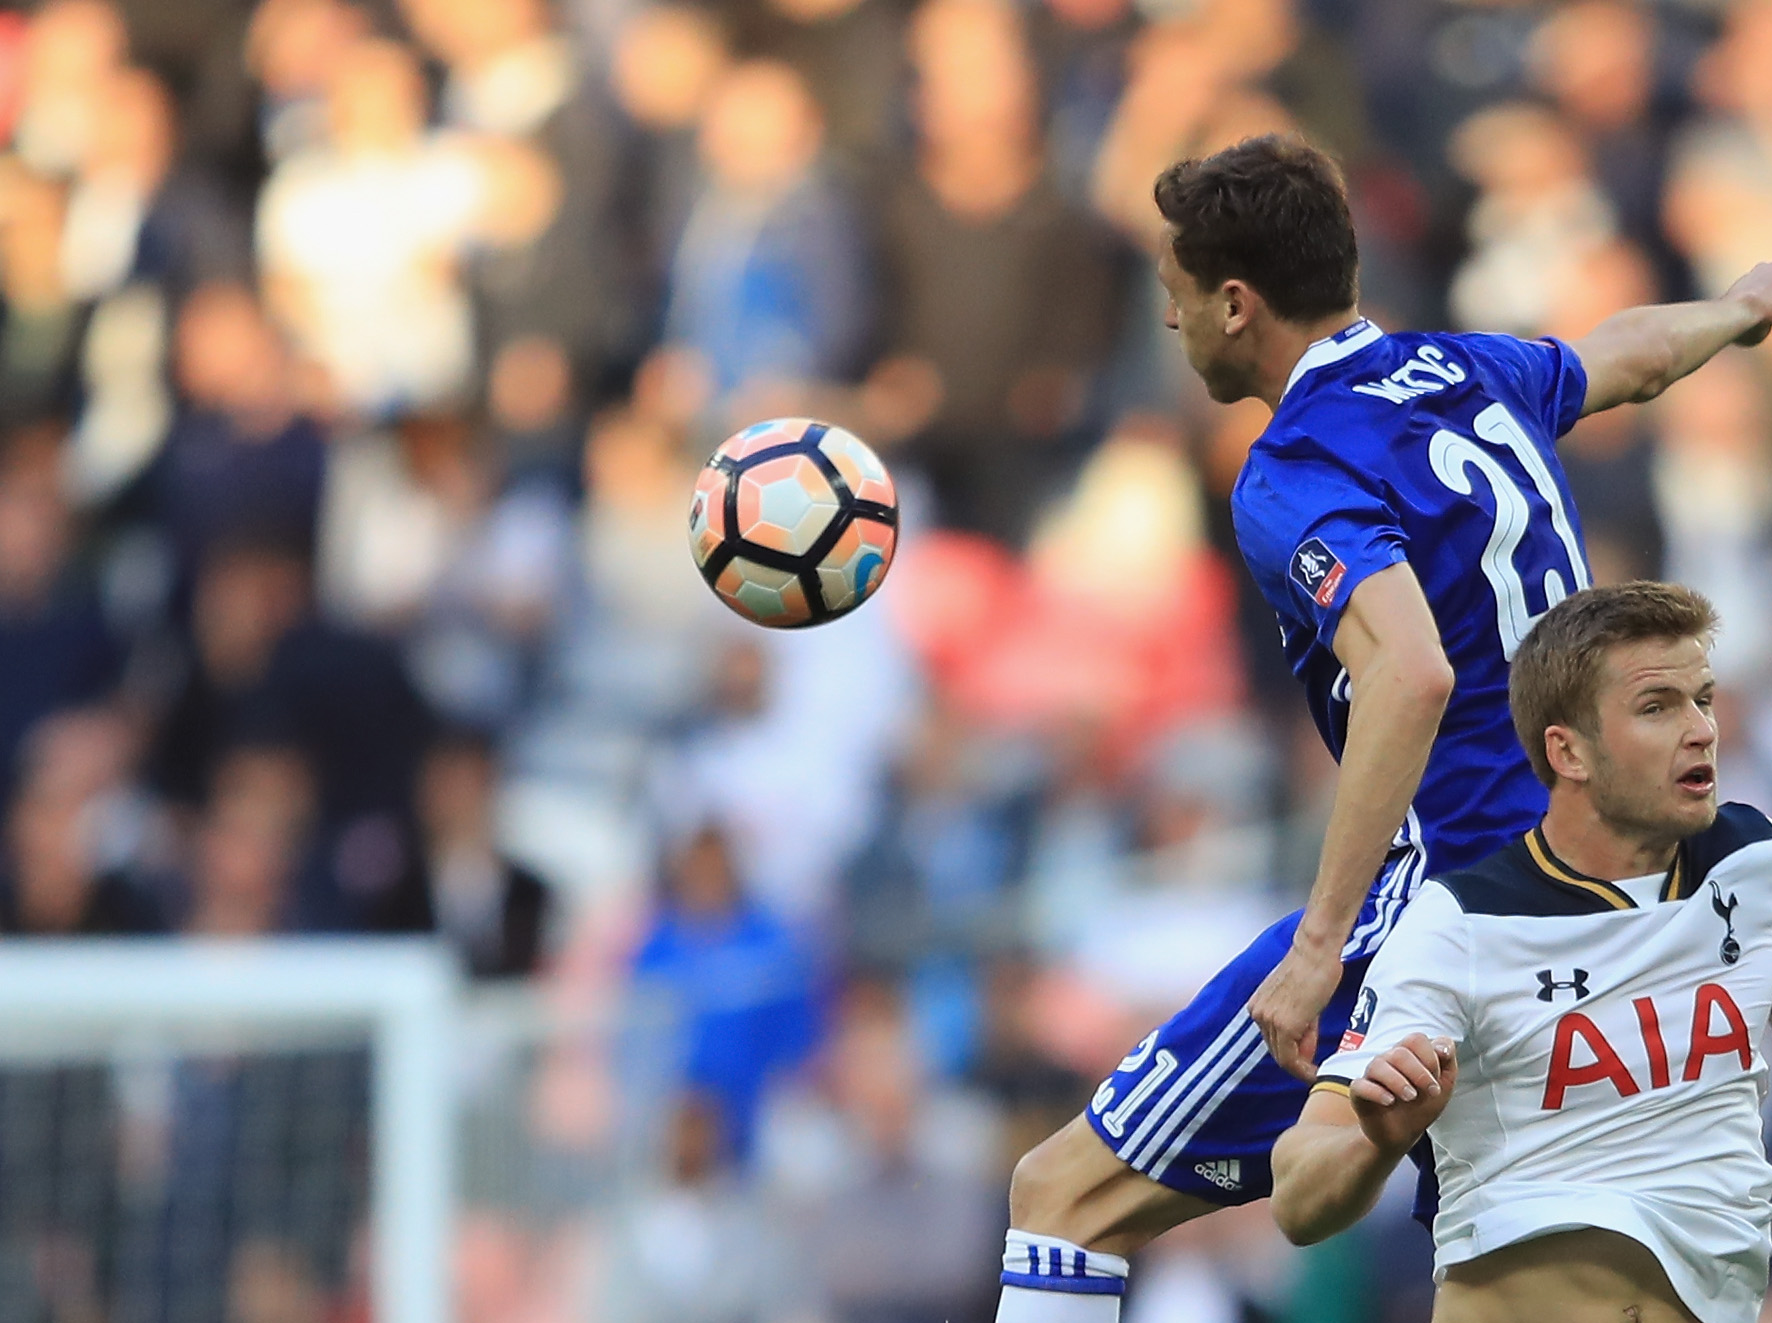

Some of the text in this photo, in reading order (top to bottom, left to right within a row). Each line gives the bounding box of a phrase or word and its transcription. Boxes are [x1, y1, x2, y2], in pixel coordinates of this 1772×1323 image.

[1428, 402, 1596, 662] 21
[1091, 1029, 1178, 1138] 21
[1540, 982, 1754, 1111] AIA
